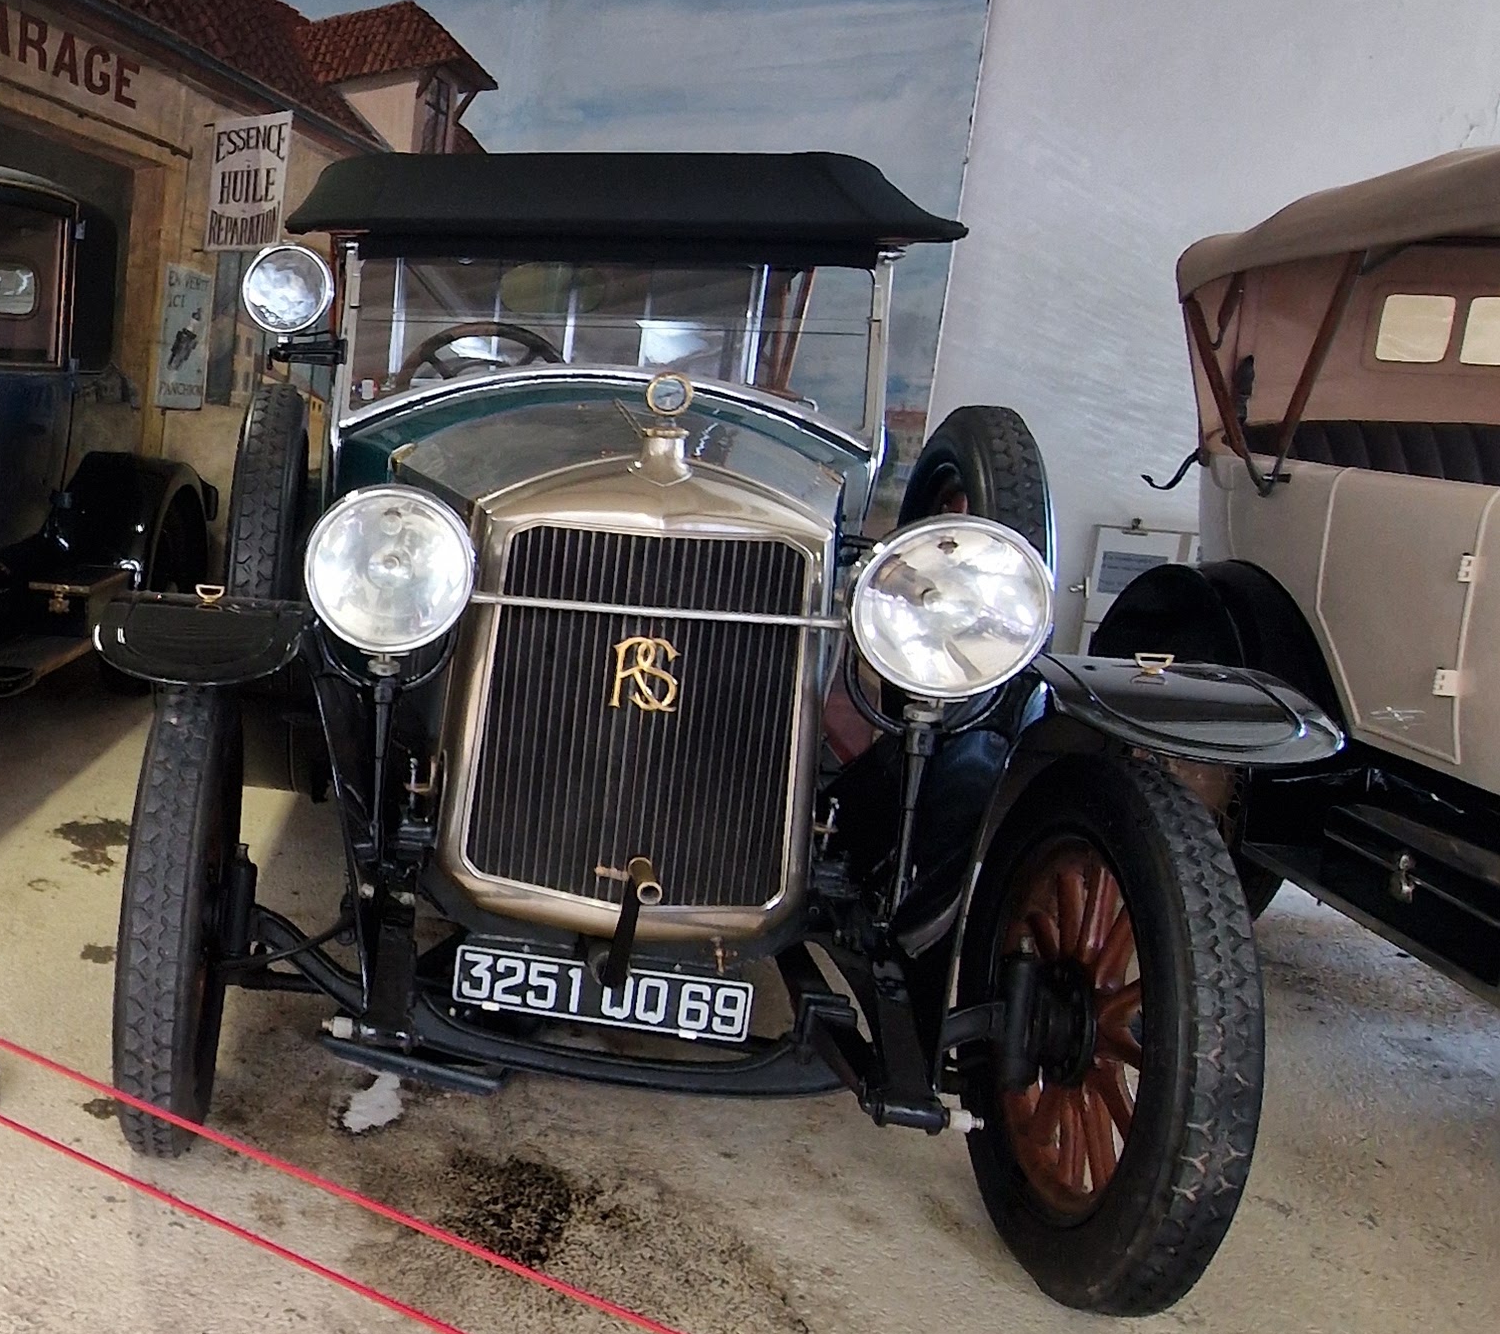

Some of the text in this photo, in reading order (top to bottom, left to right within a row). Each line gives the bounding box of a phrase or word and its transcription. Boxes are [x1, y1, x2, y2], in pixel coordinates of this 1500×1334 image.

[215, 122, 288, 163] ESSENCE
[218, 165, 277, 204] HUILE
[208, 200, 280, 246] REPARATION
[460, 952, 583, 1014] 3251
[677, 982, 748, 1035] 69
